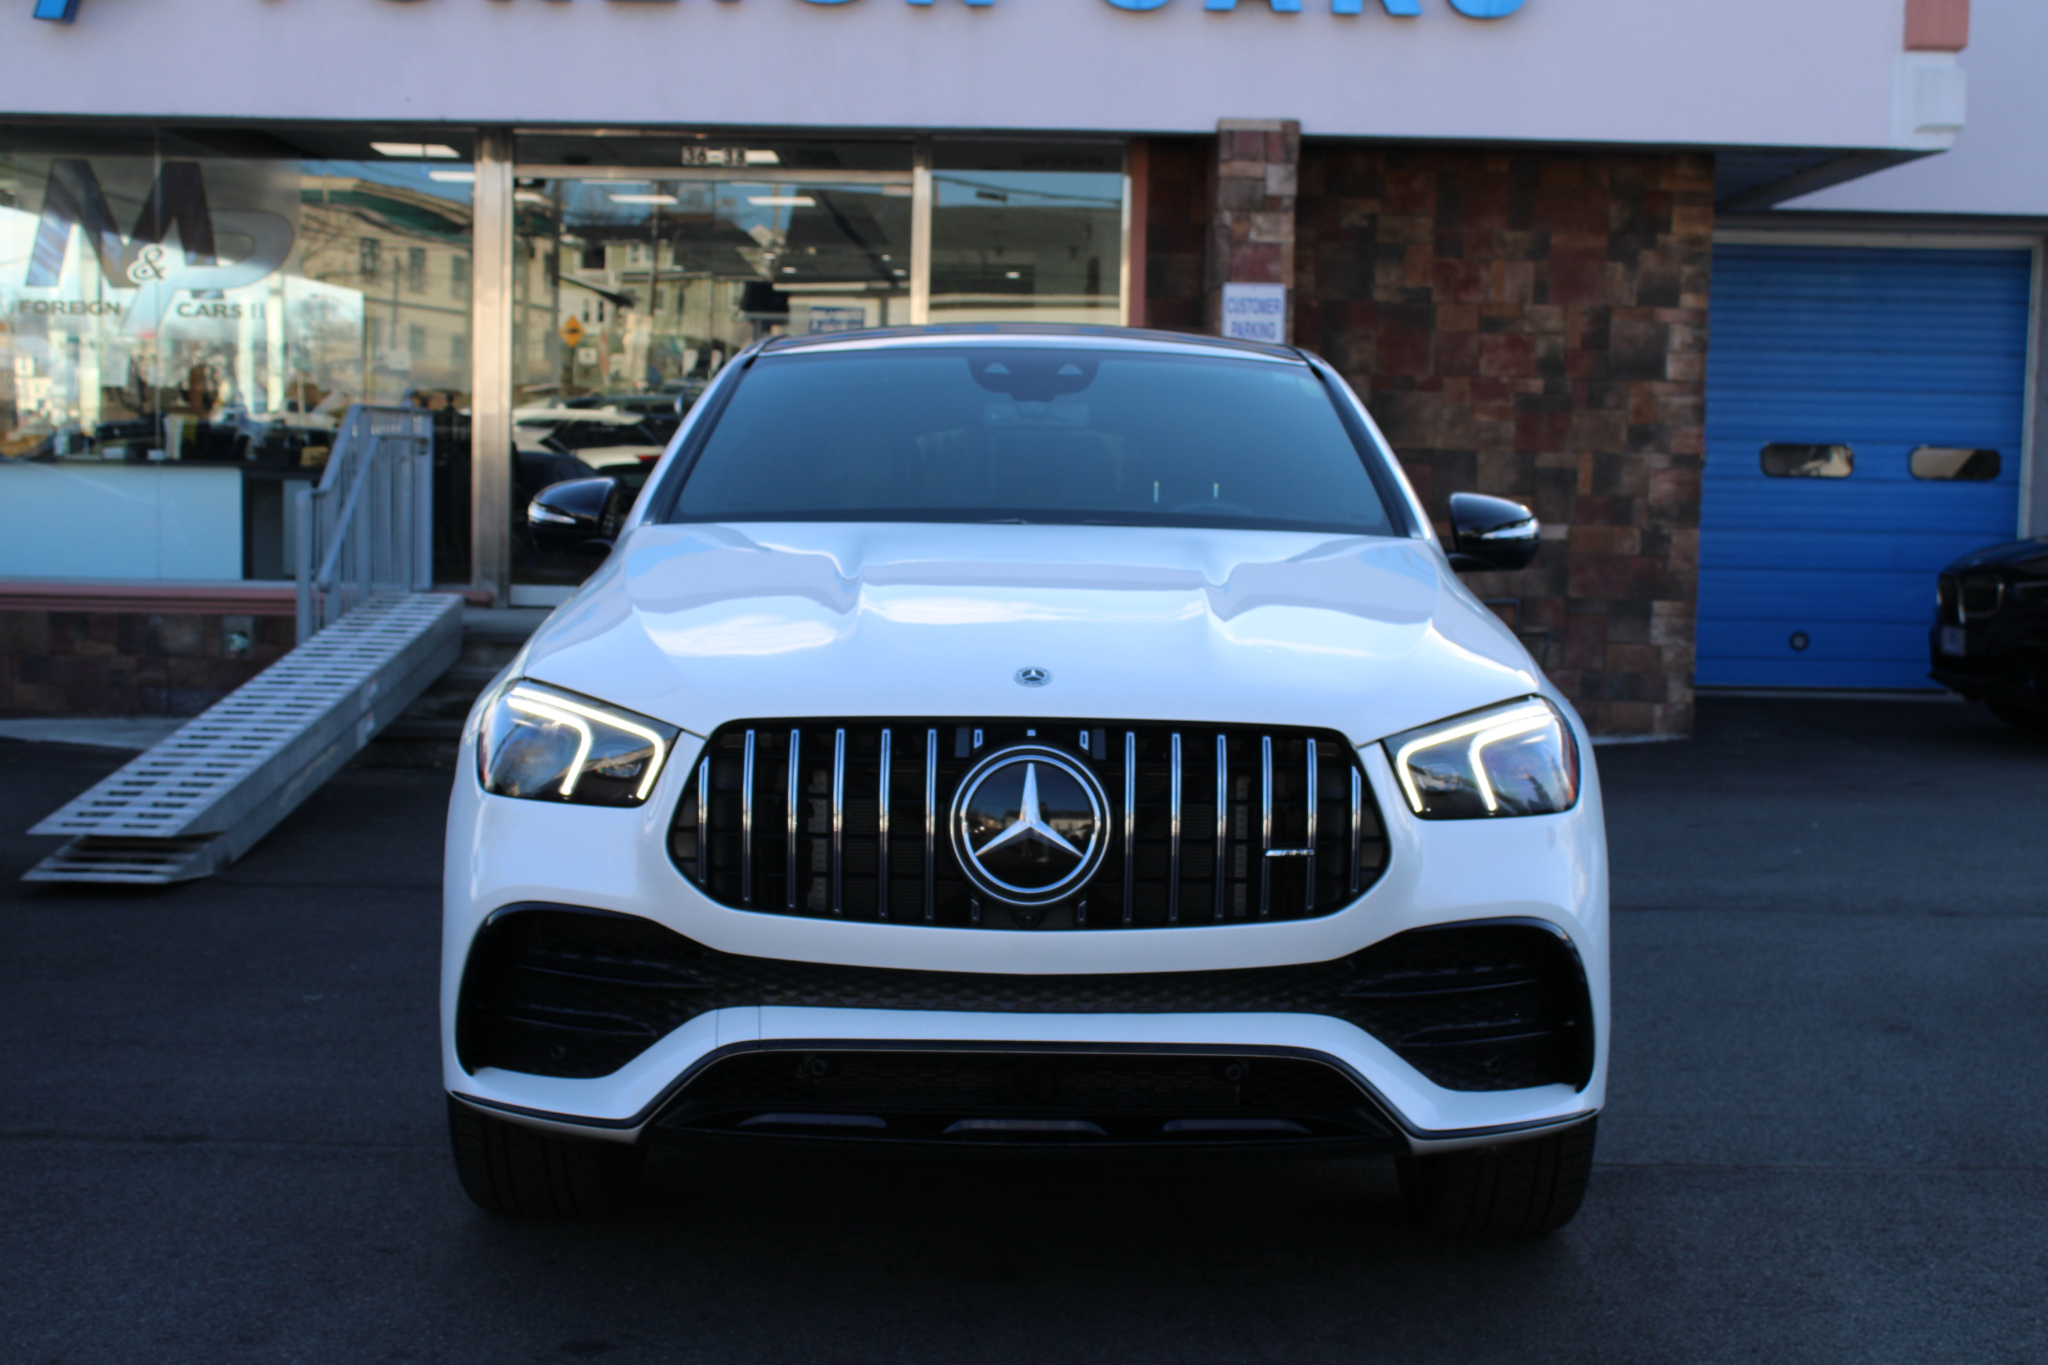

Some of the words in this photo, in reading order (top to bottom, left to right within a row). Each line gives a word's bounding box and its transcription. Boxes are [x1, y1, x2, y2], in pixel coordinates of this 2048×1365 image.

[19, 300, 121, 315] FOREIGN
[177, 303, 242, 318] CARS
[1226, 297, 1282, 314] CUSTOMER
[1232, 321, 1277, 339] PARKING
